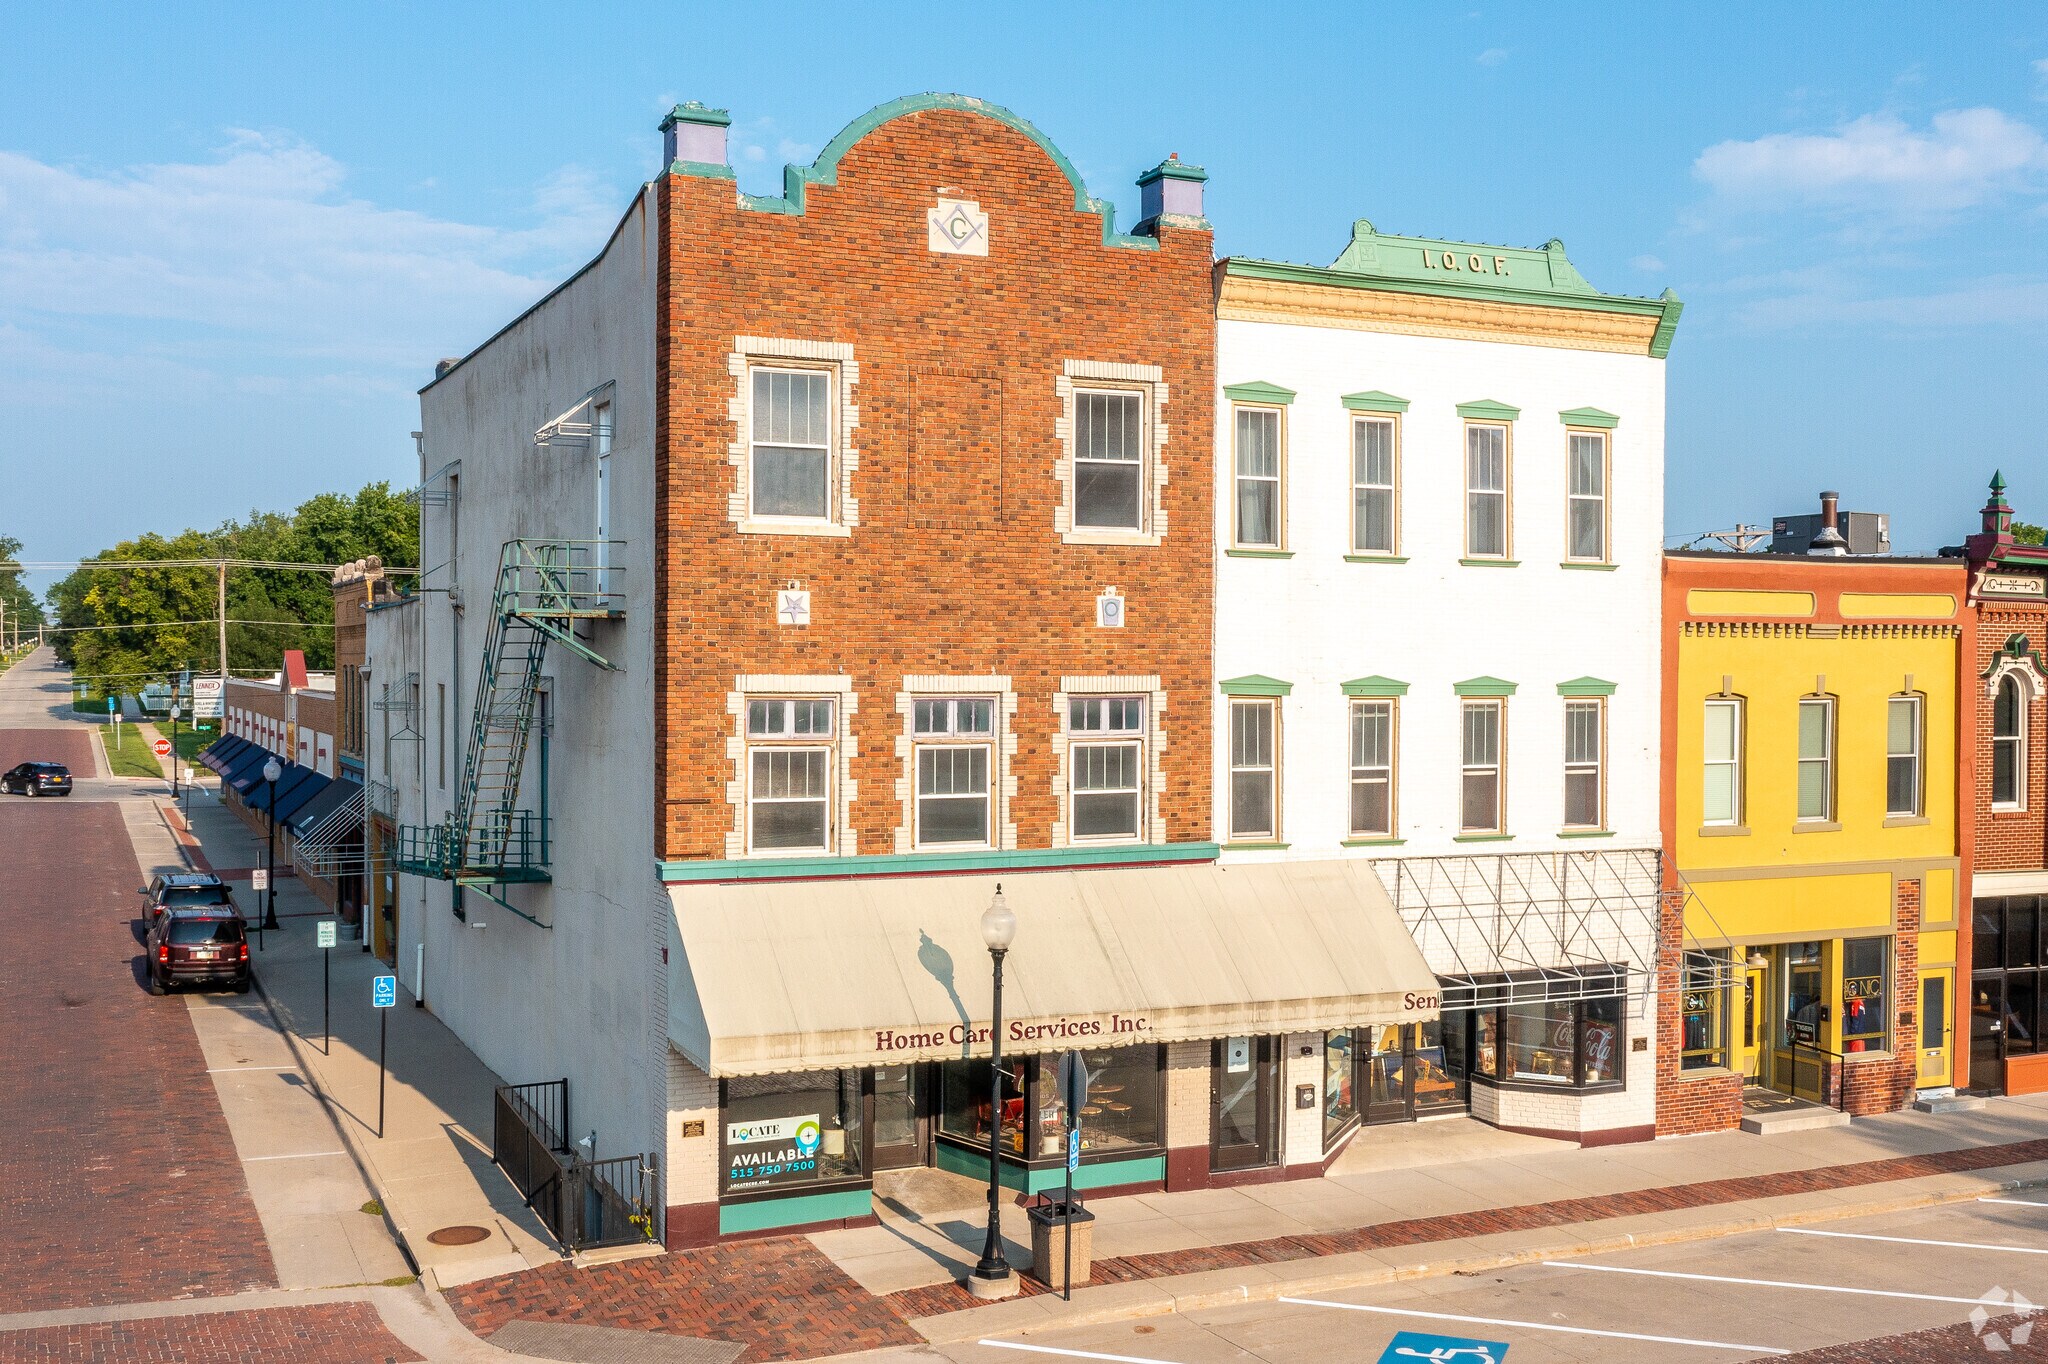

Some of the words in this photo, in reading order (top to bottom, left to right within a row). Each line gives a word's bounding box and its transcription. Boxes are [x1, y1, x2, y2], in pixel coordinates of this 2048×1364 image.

[950, 217, 967, 239] G
[876, 1030, 944, 1050] Home
[1112, 1014, 1153, 1033] Inc.
[732, 1124, 780, 1140] LOCATE
[732, 1146, 814, 1167] AVAILABLE
[731, 1167, 754, 1179] 515
[759, 1164, 781, 1176] 750
[785, 1160, 815, 1173] 7500
